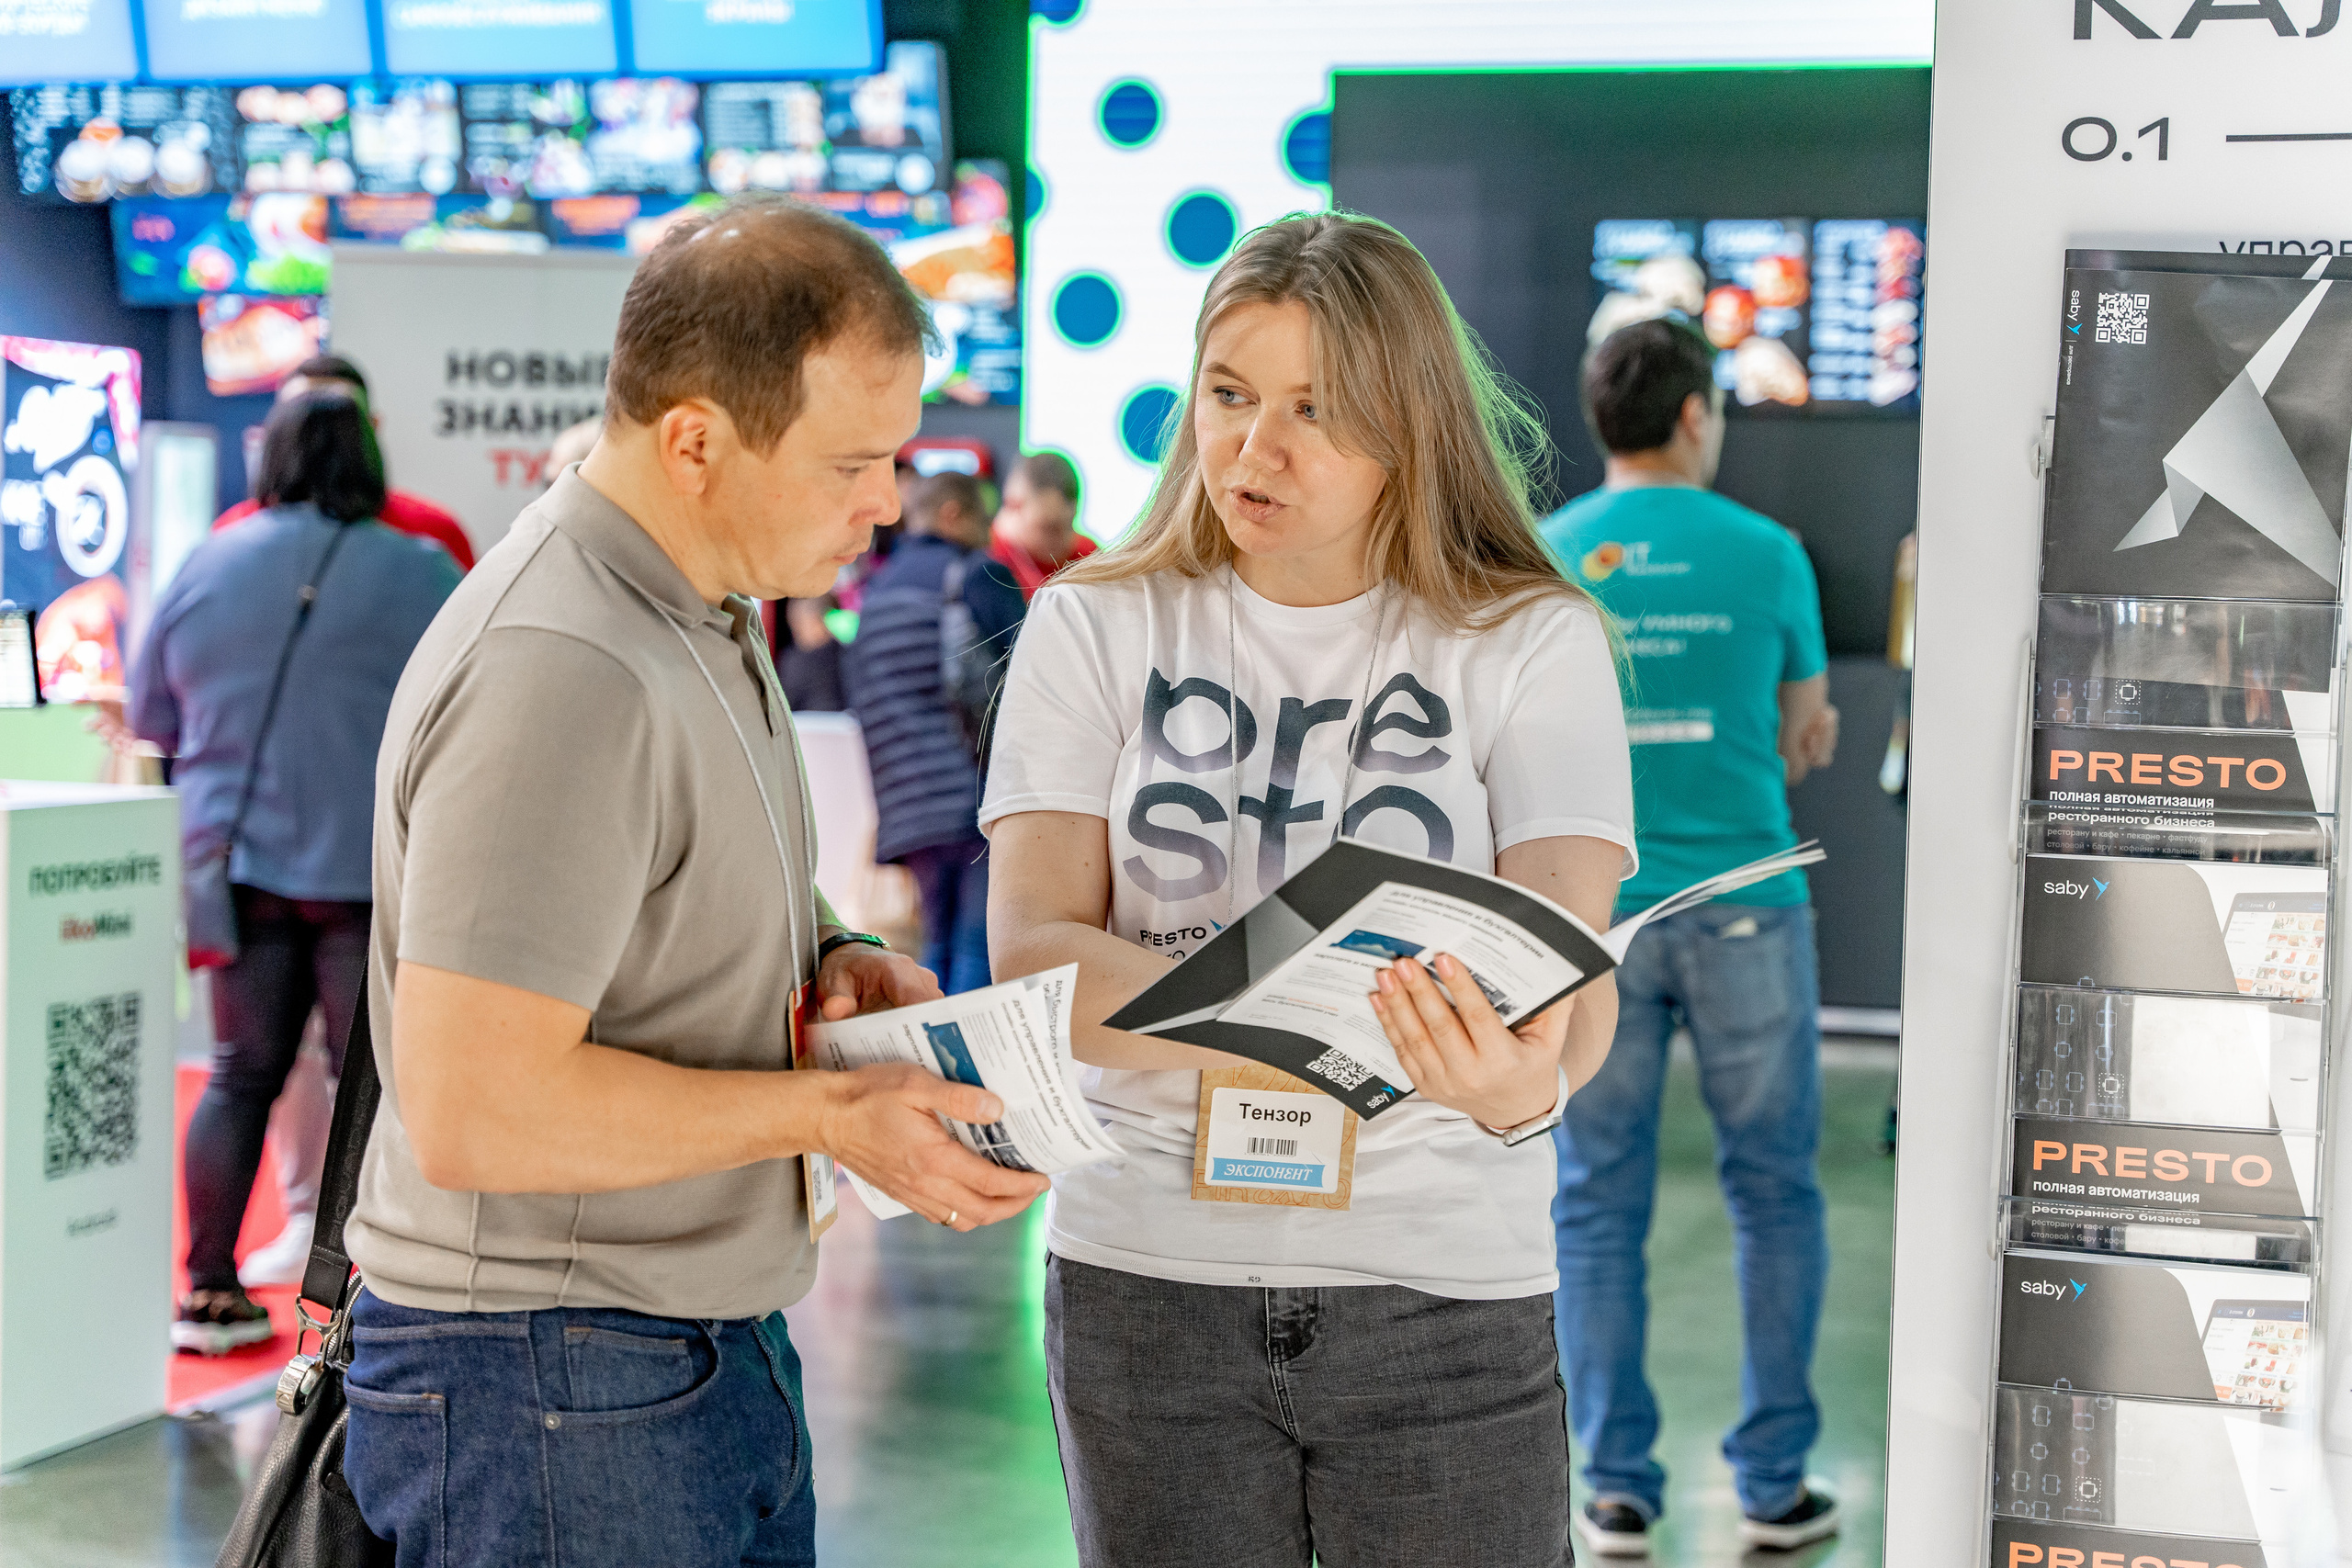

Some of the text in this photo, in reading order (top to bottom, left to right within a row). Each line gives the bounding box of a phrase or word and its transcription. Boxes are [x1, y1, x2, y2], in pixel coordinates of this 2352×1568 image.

[2062, 117, 2169, 162] 0.1
[2068, 289, 2081, 321] saby
[1140, 666, 1453, 790] pre
[2049, 749, 2287, 791] PRESTO
[2049, 791, 2215, 809] полная автоматизация
[2048, 812, 2215, 828] ресторанного бизнеса
[2047, 829, 2090, 838] ресторану
[2098, 830, 2120, 840] кафе
[2092, 843, 2112, 852] бару
[2043, 880, 2089, 899] saby
[1139, 926, 1207, 946] PRESTO
[1012, 999, 1025, 1021] для
[1020, 1021, 1052, 1085] управления
[1052, 1096, 1091, 1151] бухгалтерии
[1366, 1090, 1390, 1110] saby
[1238, 1103, 1312, 1127] Тензор
[1223, 1163, 1314, 1181] ЭКСПОНЕНТ
[2032, 1139, 2273, 1188] PRESTO
[2033, 1180, 2200, 1203] полная автоматизация
[2031, 1206, 2201, 1225] ресторанного бизнеса
[2031, 1219, 2075, 1230] ресторану
[2020, 1280, 2066, 1301] saby
